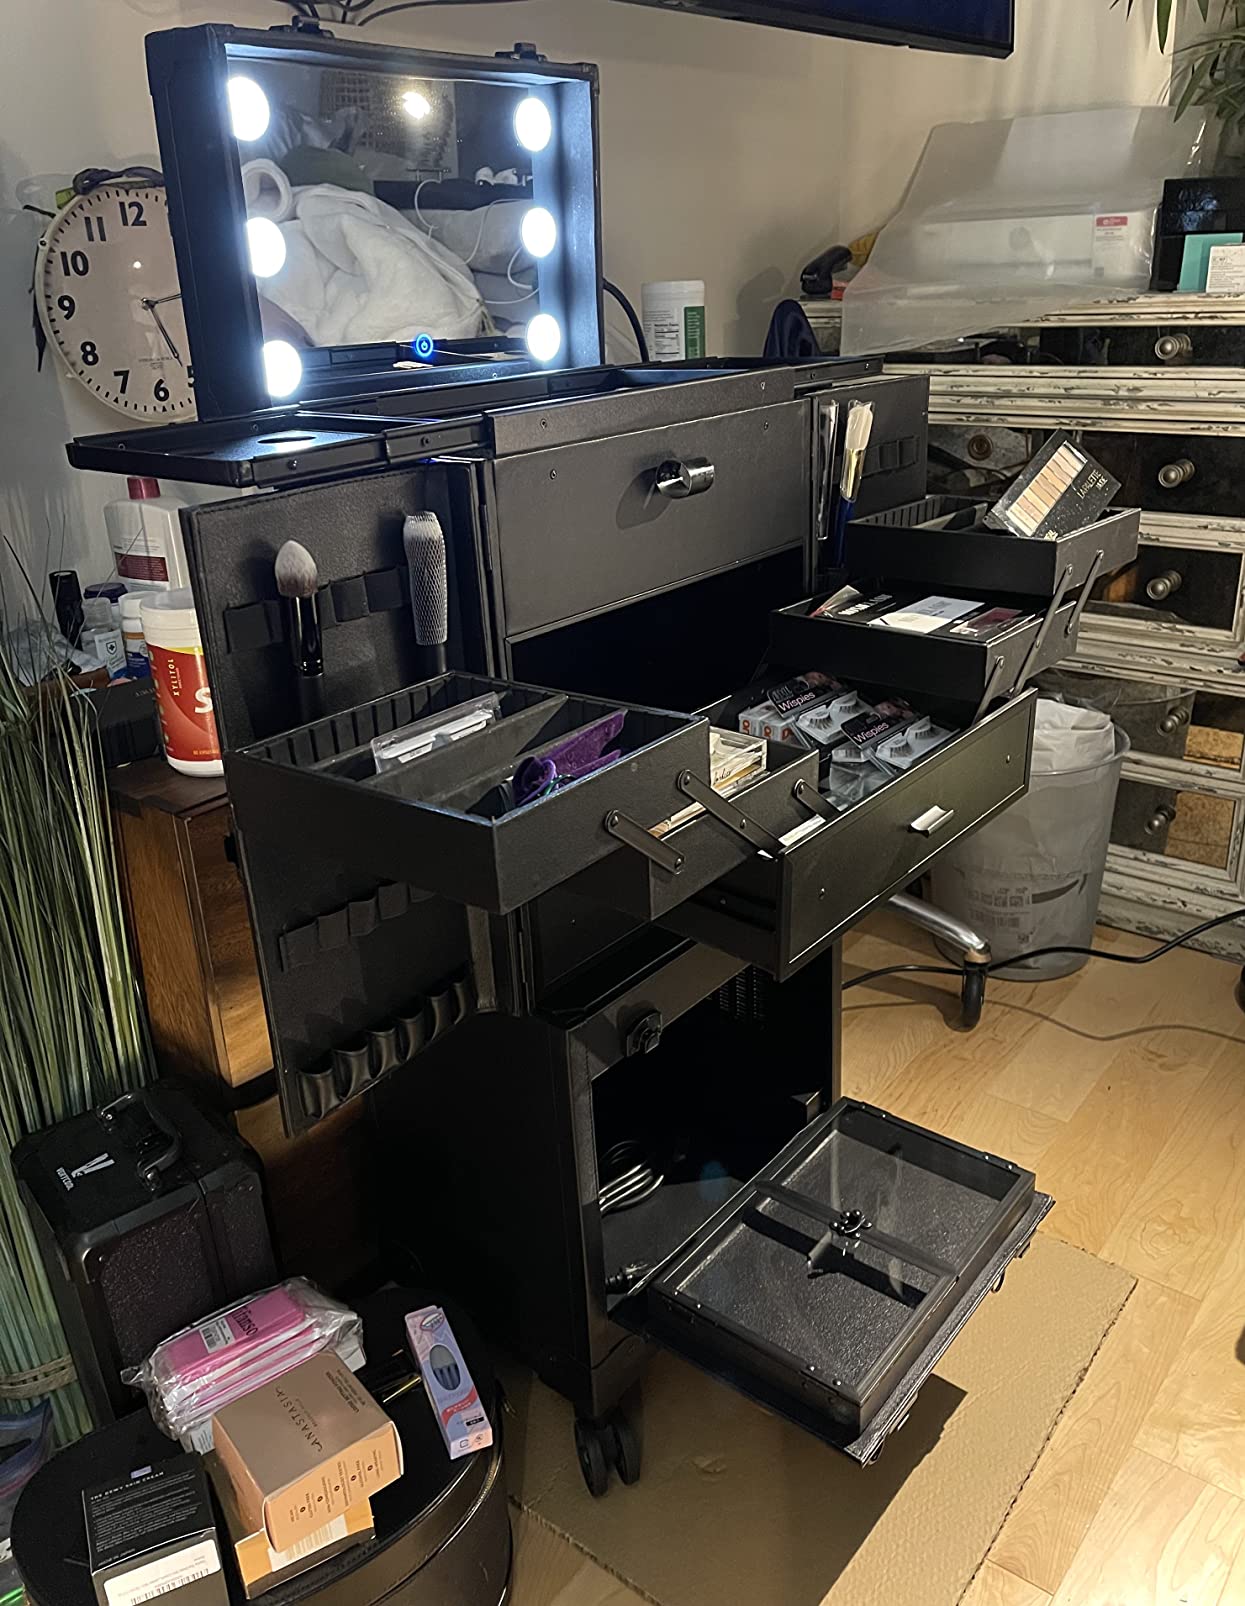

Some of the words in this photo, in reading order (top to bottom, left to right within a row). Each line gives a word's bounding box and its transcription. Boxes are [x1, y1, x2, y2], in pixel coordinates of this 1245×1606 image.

[119, 201, 147, 227] 12
[84, 216, 107, 242] 11
[60, 250, 89, 277] 10
[57, 295, 76, 320] 9
[80, 341, 99, 366] 8
[113, 369, 130, 394] 7
[153, 378, 170, 402] 6
[167, 659, 180, 697] XYLITOL
[778, 690, 816, 712] Wispies
[853, 721, 890, 744] Wispies
[275, 1386, 323, 1452] ANASTASIA
